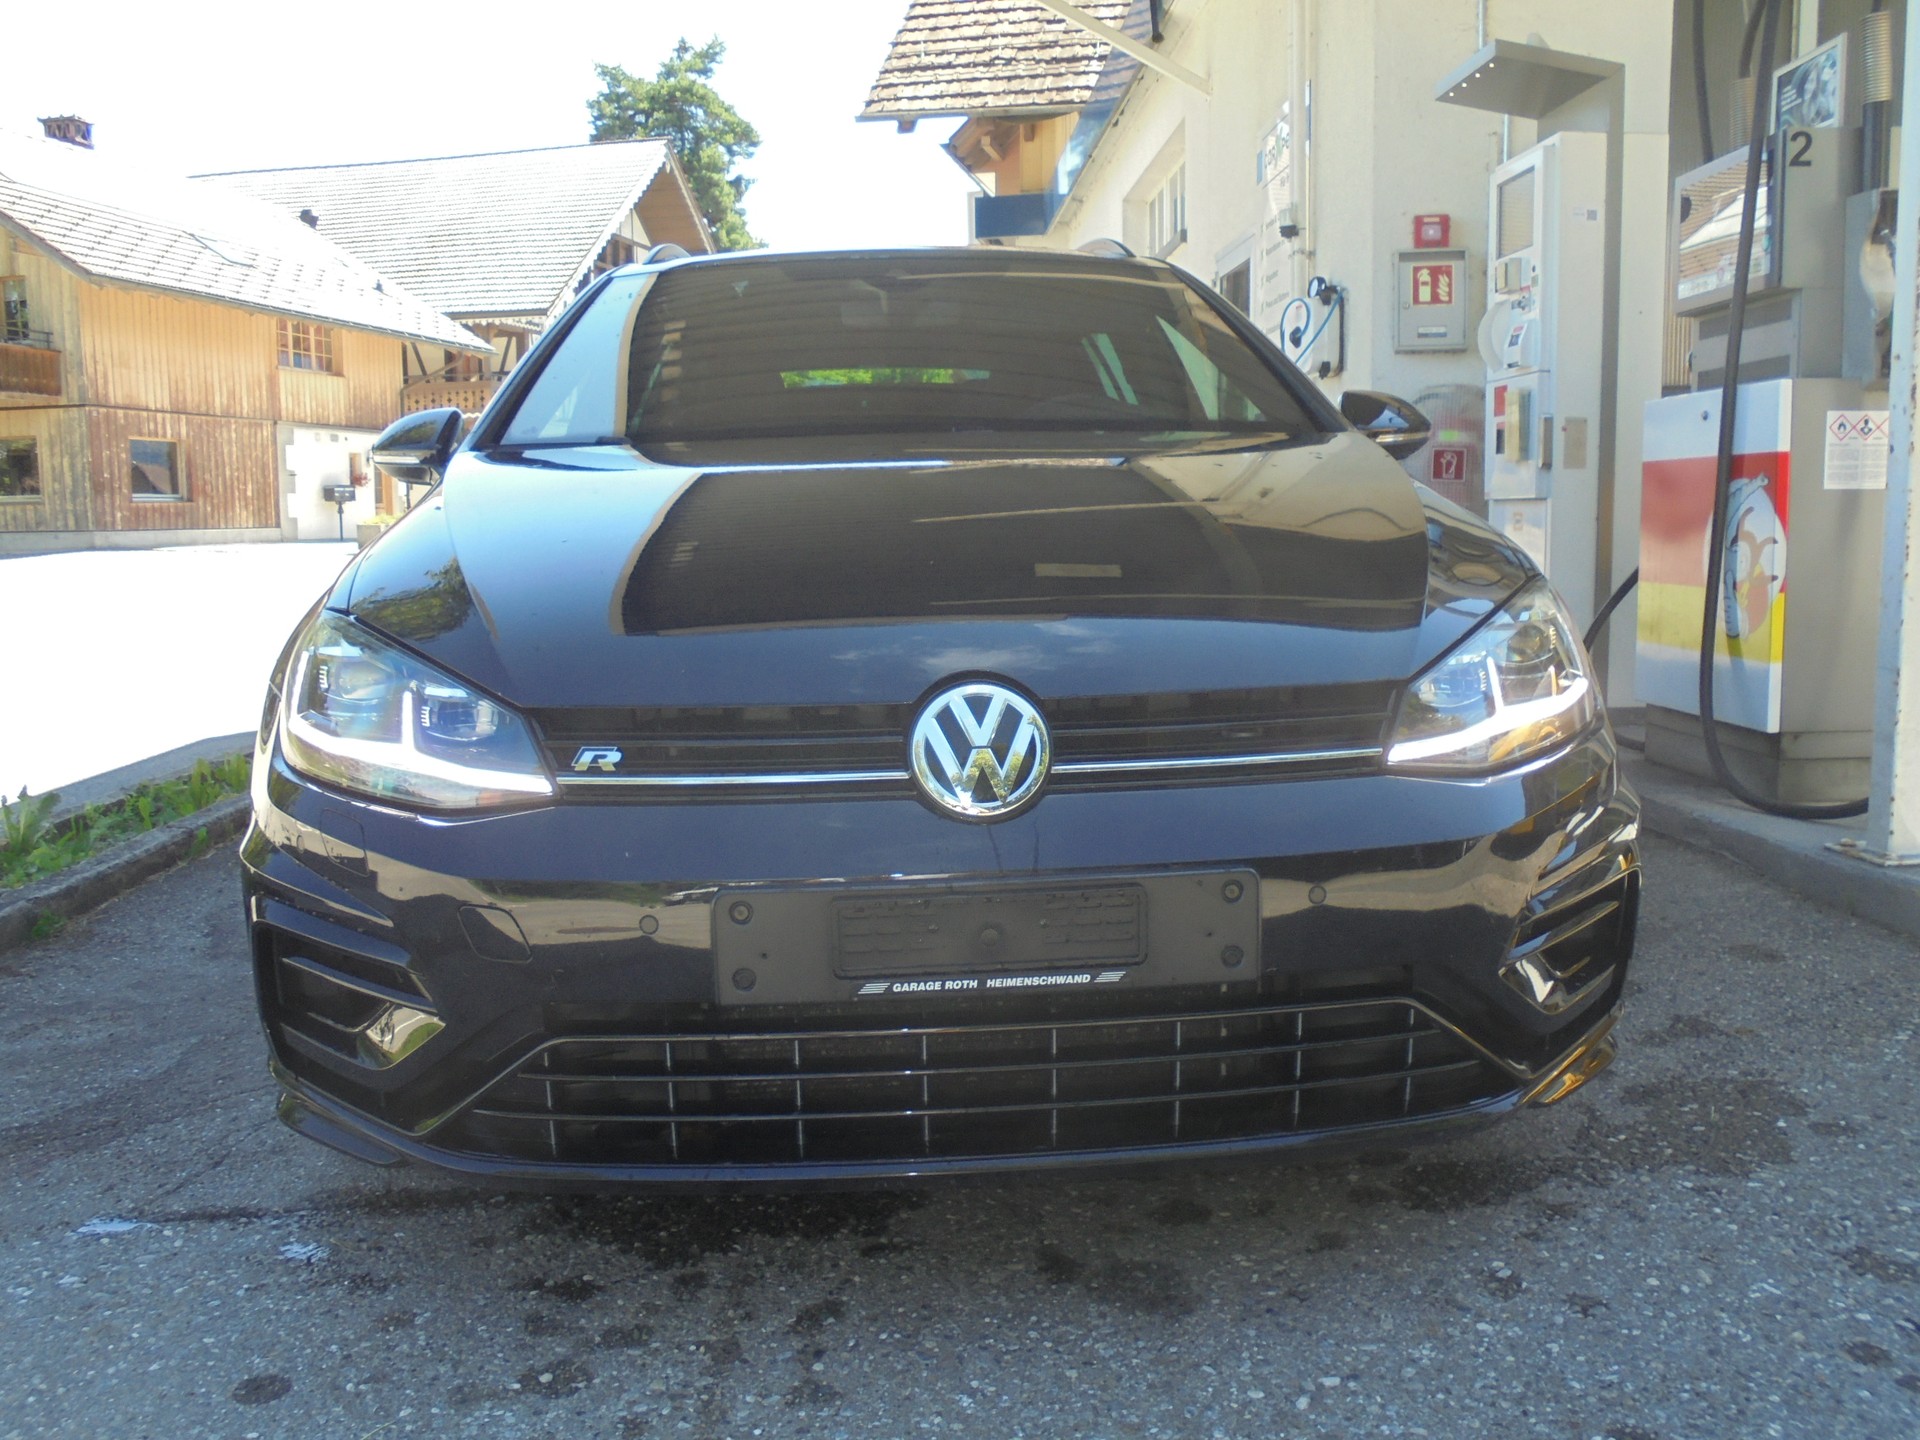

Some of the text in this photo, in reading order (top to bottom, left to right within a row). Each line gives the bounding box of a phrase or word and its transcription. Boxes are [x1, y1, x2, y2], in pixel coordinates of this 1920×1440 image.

[1789, 131, 1812, 167] 2
[571, 746, 622, 771] R
[913, 685, 1049, 815] VW
[892, 974, 1091, 993] GARAGE ROTH HEIMENSCHWAND
